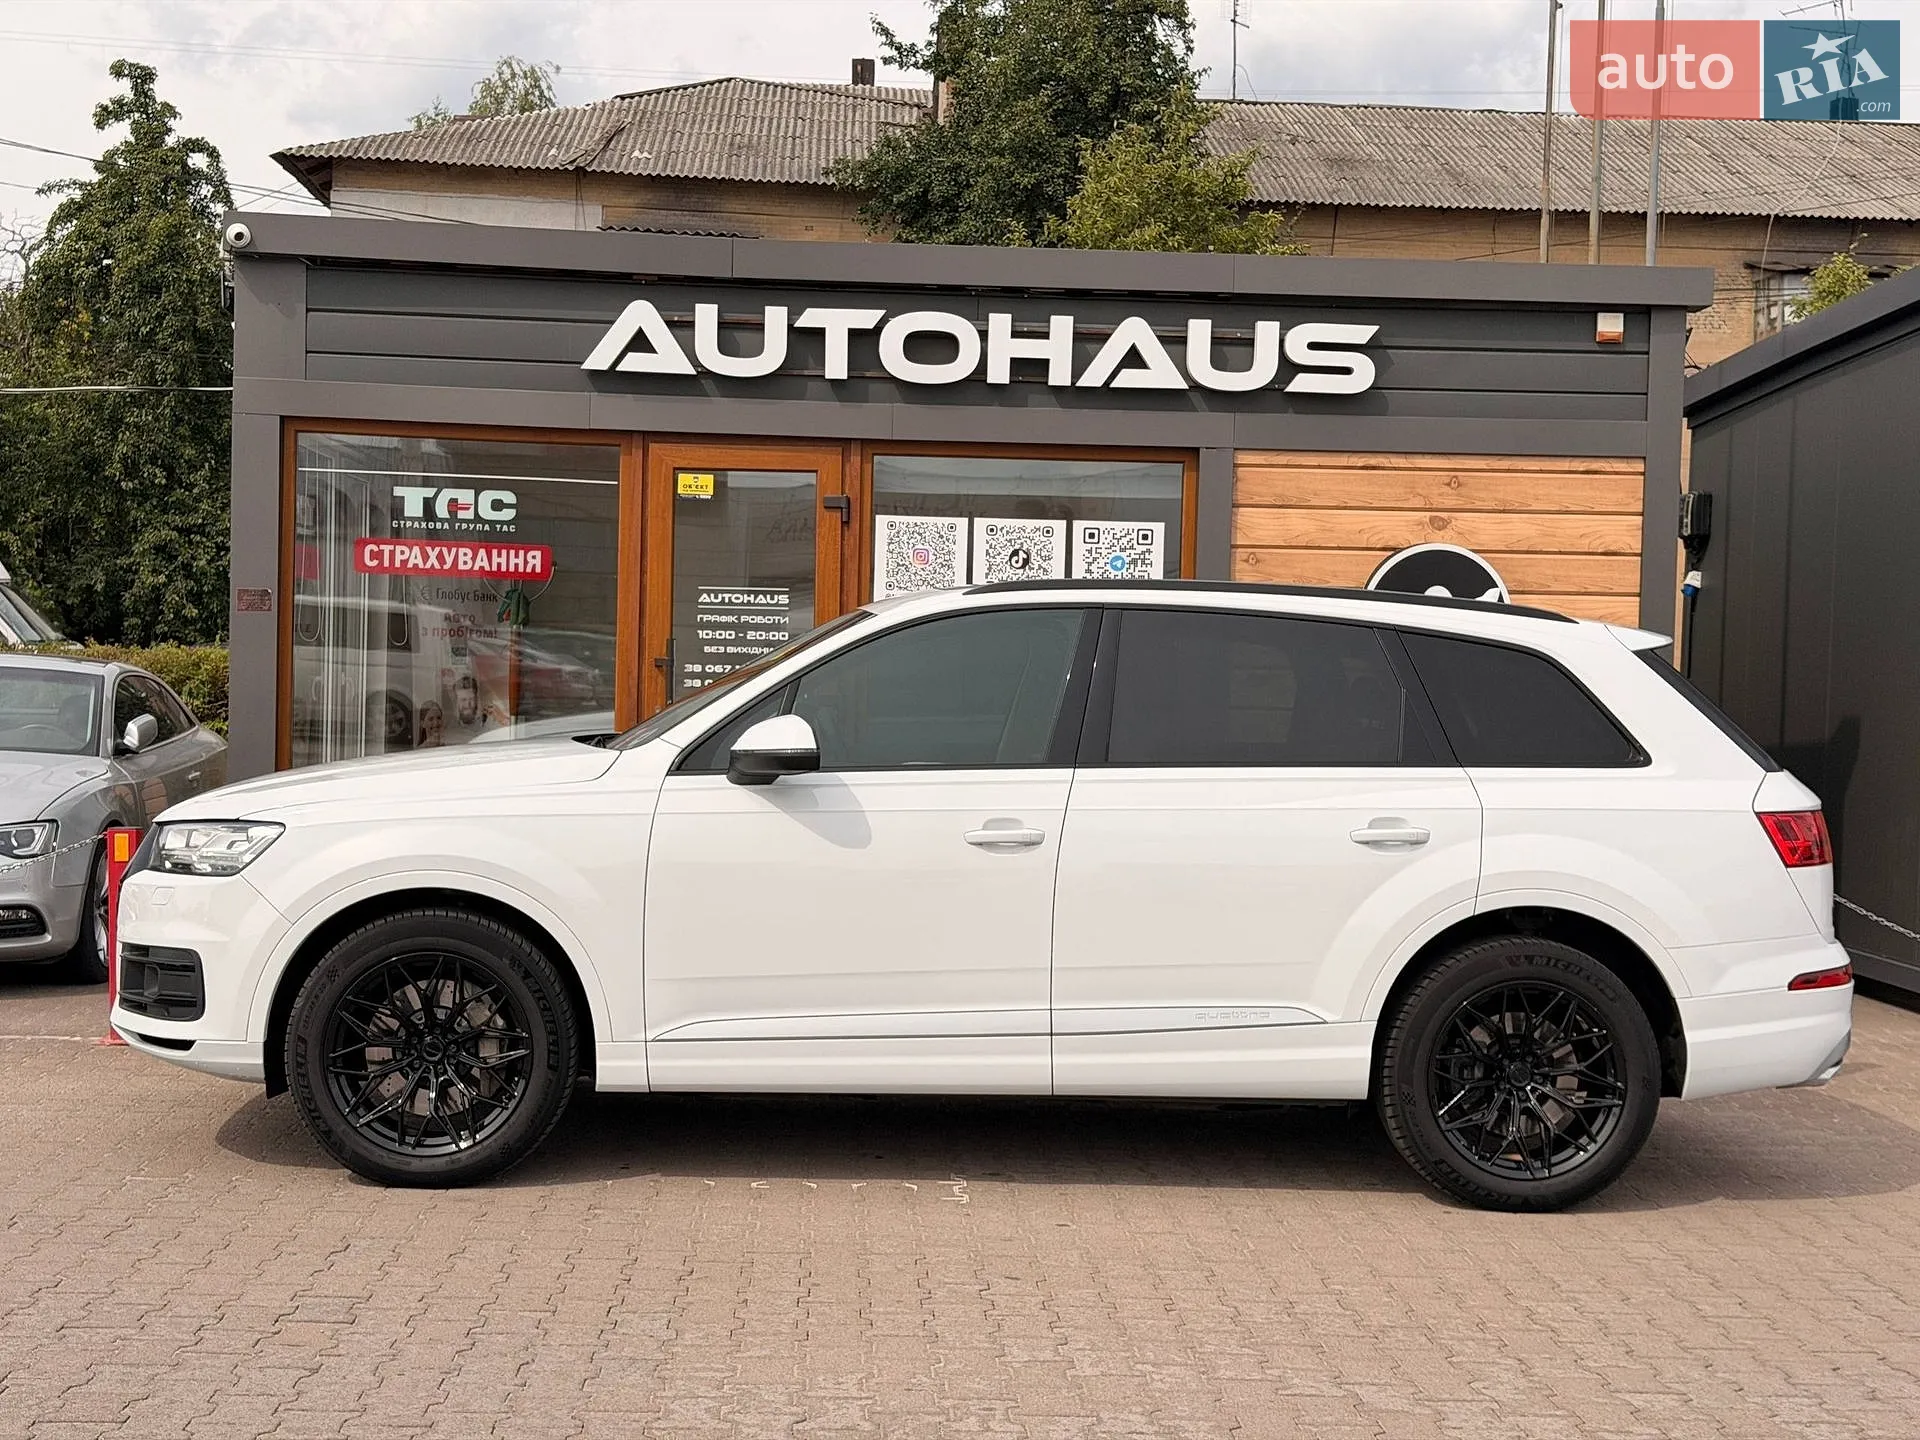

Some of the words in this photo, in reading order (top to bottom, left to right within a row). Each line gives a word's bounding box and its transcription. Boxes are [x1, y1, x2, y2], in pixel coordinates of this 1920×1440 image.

[580, 299, 1380, 395] AUTOHAUS
[392, 520, 450, 530] СТРАХОВА
[455, 523, 490, 532] ГРУПА
[496, 524, 516, 533] ТАС
[364, 543, 542, 574] СТРАХУВАННЯ
[436, 587, 470, 603] Глобус
[698, 593, 789, 604] AUTOHAUS
[697, 614, 739, 623] ГРАФІК
[740, 615, 789, 624] РОБОТИ
[697, 630, 736, 639] 10:00
[746, 631, 789, 641] 20:00
[703, 645, 725, 654] БЕЗ
[726, 646, 775, 655] ВИХІДНИ
[683, 664, 702, 673] 38
[705, 664, 732, 673] 067
